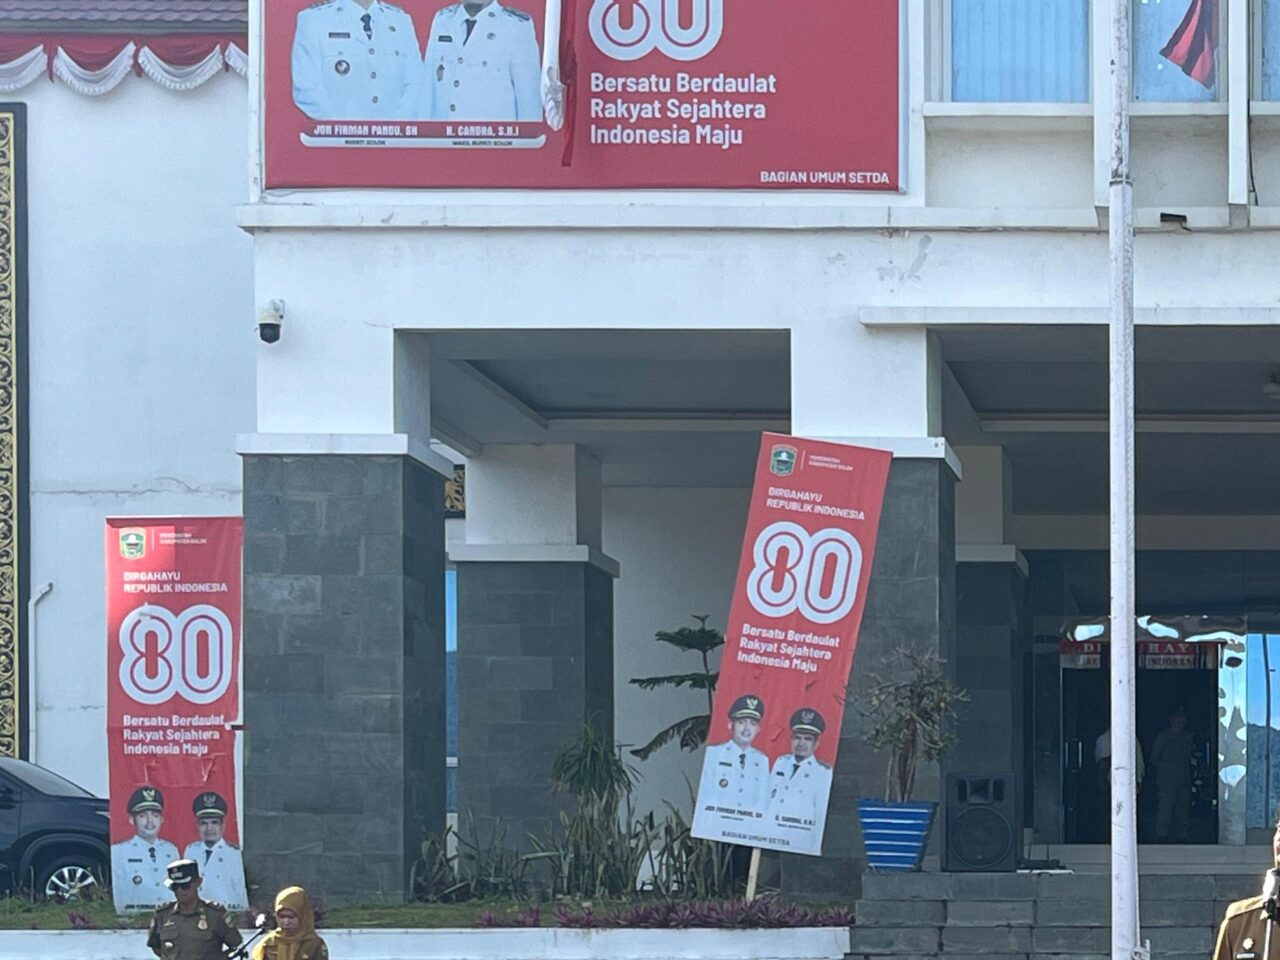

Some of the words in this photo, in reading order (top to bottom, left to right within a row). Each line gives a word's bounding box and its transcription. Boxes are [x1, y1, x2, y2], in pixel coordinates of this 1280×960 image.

[590, 72, 671, 93] Bersatu
[676, 73, 776, 93] Berdaulat
[590, 98, 661, 123] Rakyat
[666, 99, 766, 123] Sejahtera
[590, 124, 690, 145] Indonesia
[695, 124, 743, 150] Maju
[760, 170, 807, 184] BAGIAN
[809, 171, 846, 184] UMUM
[848, 171, 889, 185] SETDA
[768, 487, 823, 502] DIRGAHAYU
[766, 498, 813, 513] REPUBLIK
[813, 504, 865, 520] INDONESIA
[123, 571, 181, 581] DIRGAHAYU
[746, 521, 863, 624] 80
[123, 583, 172, 593] REPUBLIK
[175, 583, 228, 592] INDONESIA
[742, 623, 785, 639] Bersatu
[786, 630, 840, 647] Berdaulat
[119, 604, 233, 705] 80
[740, 637, 778, 653] Rakyat
[779, 643, 832, 660] Sejahtera
[737, 650, 790, 668] Indonesia
[791, 658, 818, 673] Maju
[123, 715, 169, 726] Bersatu
[172, 714, 224, 725] Berdaulat
[123, 729, 163, 742] Rakyat
[166, 729, 220, 742] Sejahtera
[123, 743, 180, 754] Indonesia
[182, 743, 208, 757] Maju
